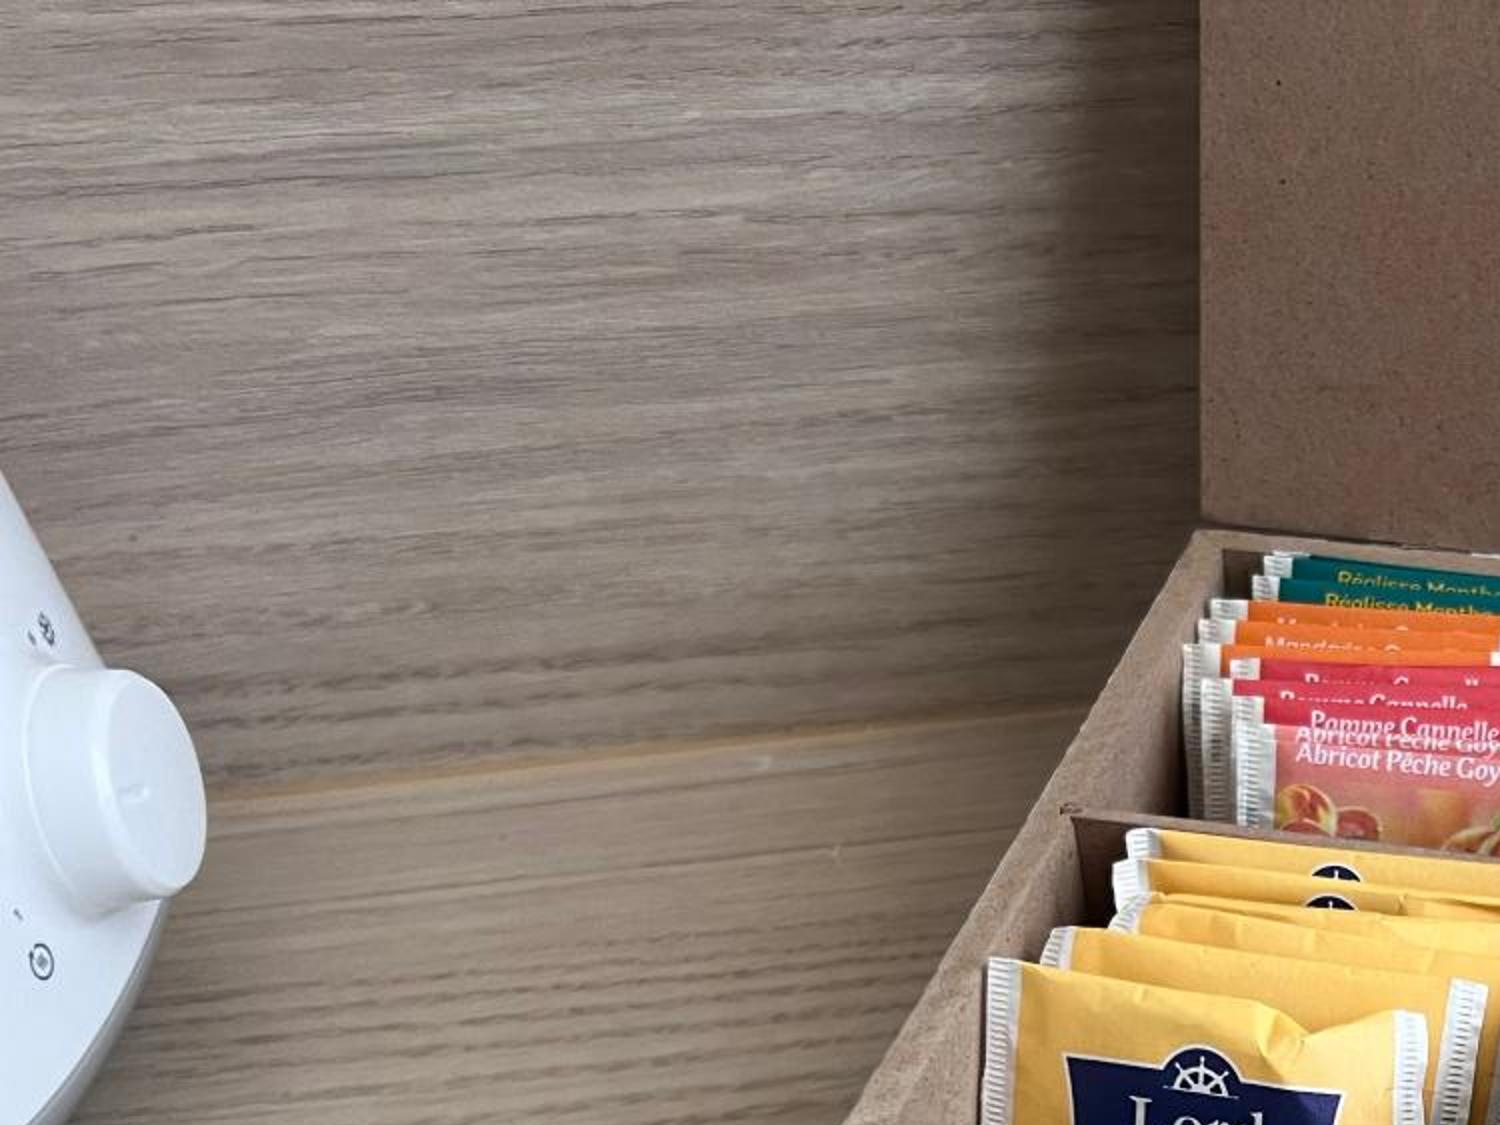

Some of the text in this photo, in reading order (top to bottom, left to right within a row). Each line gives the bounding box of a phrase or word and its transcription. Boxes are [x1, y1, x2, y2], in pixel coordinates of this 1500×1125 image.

[1400, 716, 1500, 743] Cannelle
[1296, 743, 1379, 771] Abricot
[1386, 751, 1451, 777] Pêche
